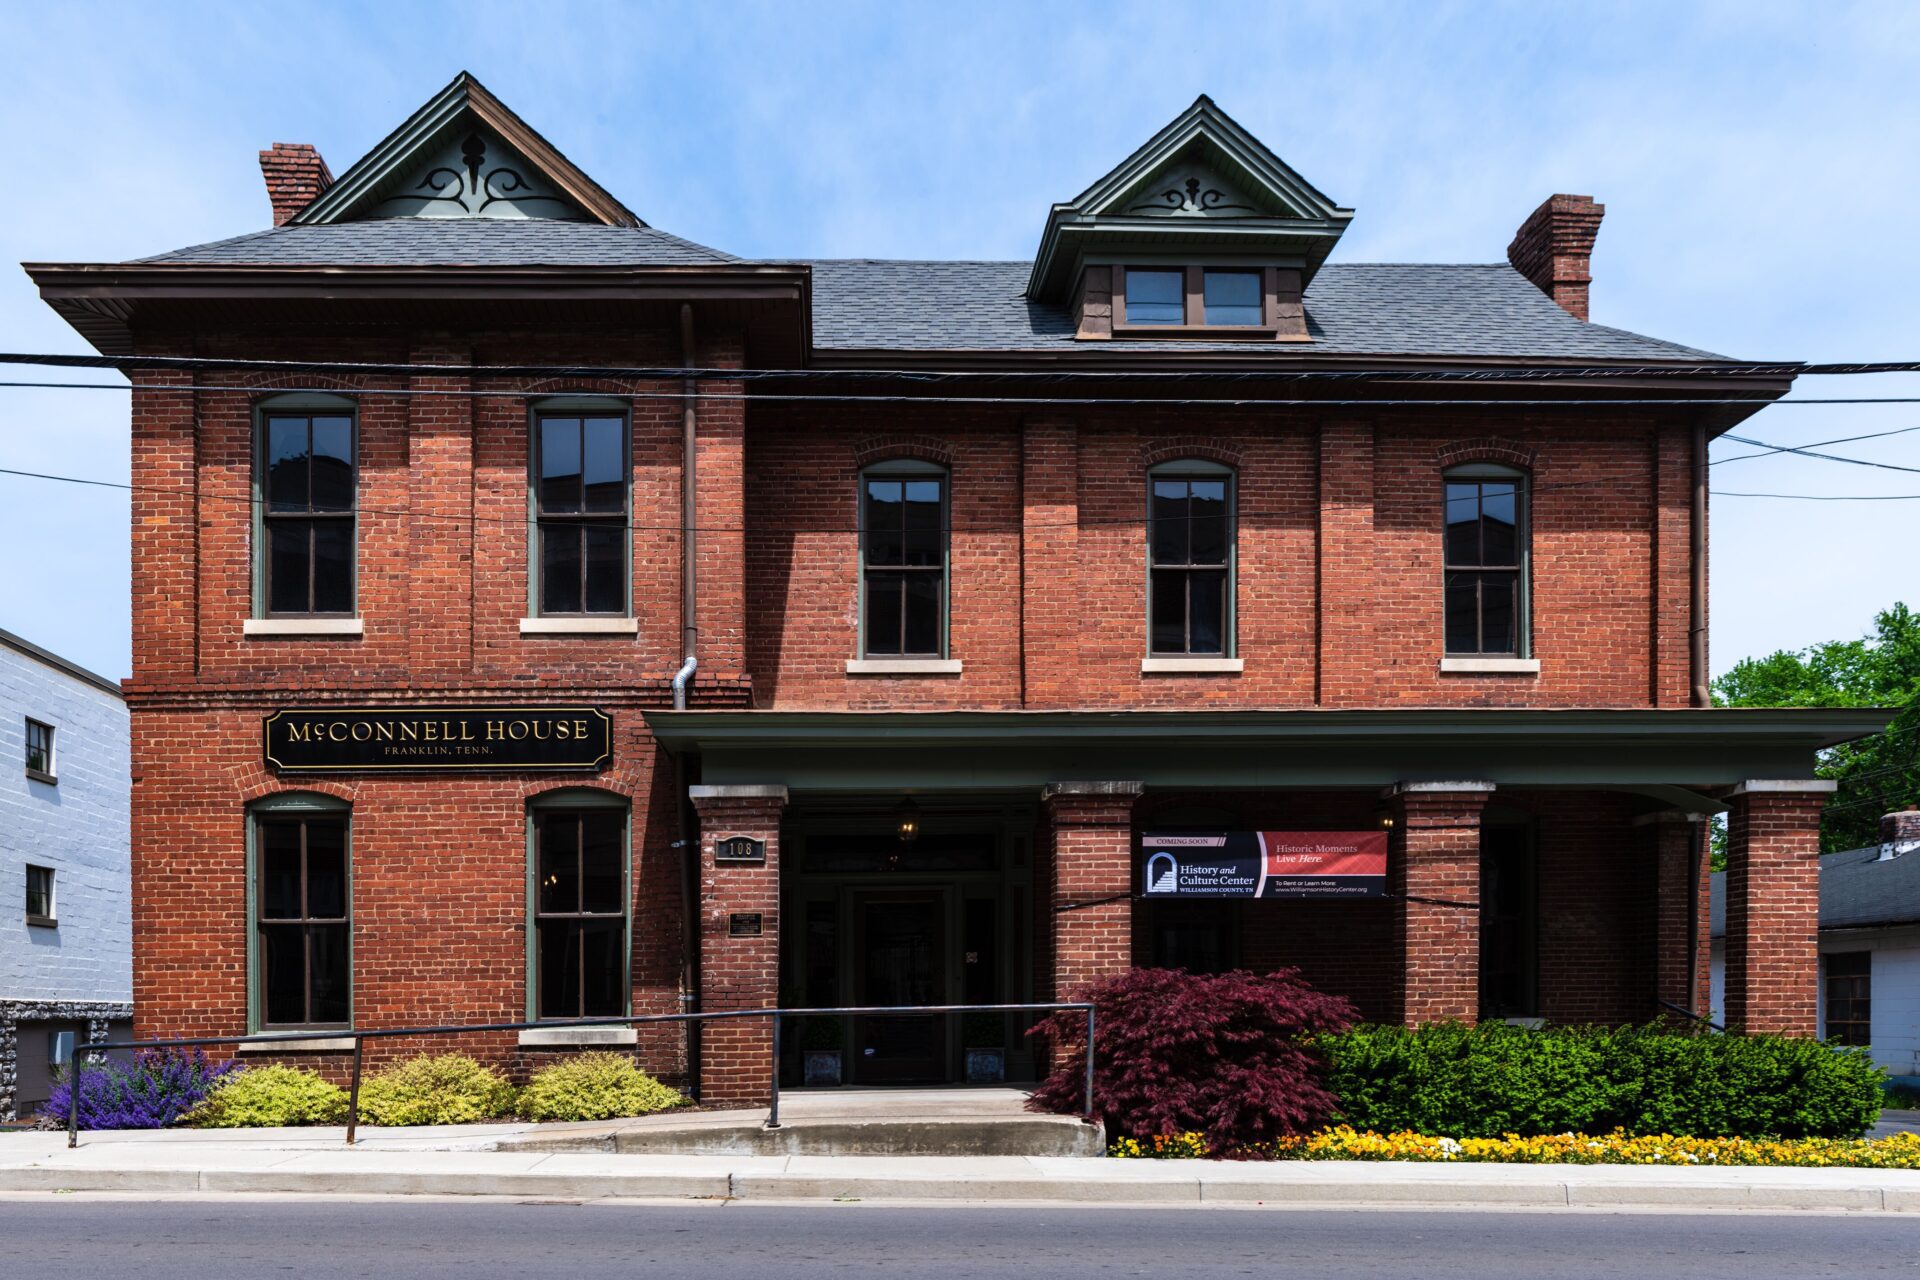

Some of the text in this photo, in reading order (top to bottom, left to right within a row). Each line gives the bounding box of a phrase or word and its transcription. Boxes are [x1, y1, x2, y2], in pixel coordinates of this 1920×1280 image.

[485, 719, 590, 741] HOUSE
[384, 745, 495, 756] FRANKLIN, TENN.
[730, 842, 751, 855] 108
[1276, 844, 1358, 853] Historic Moments
[1276, 854, 1323, 863] Live Here.
[1180, 865, 1236, 876] History and
[1180, 875, 1254, 885] Culture Center
